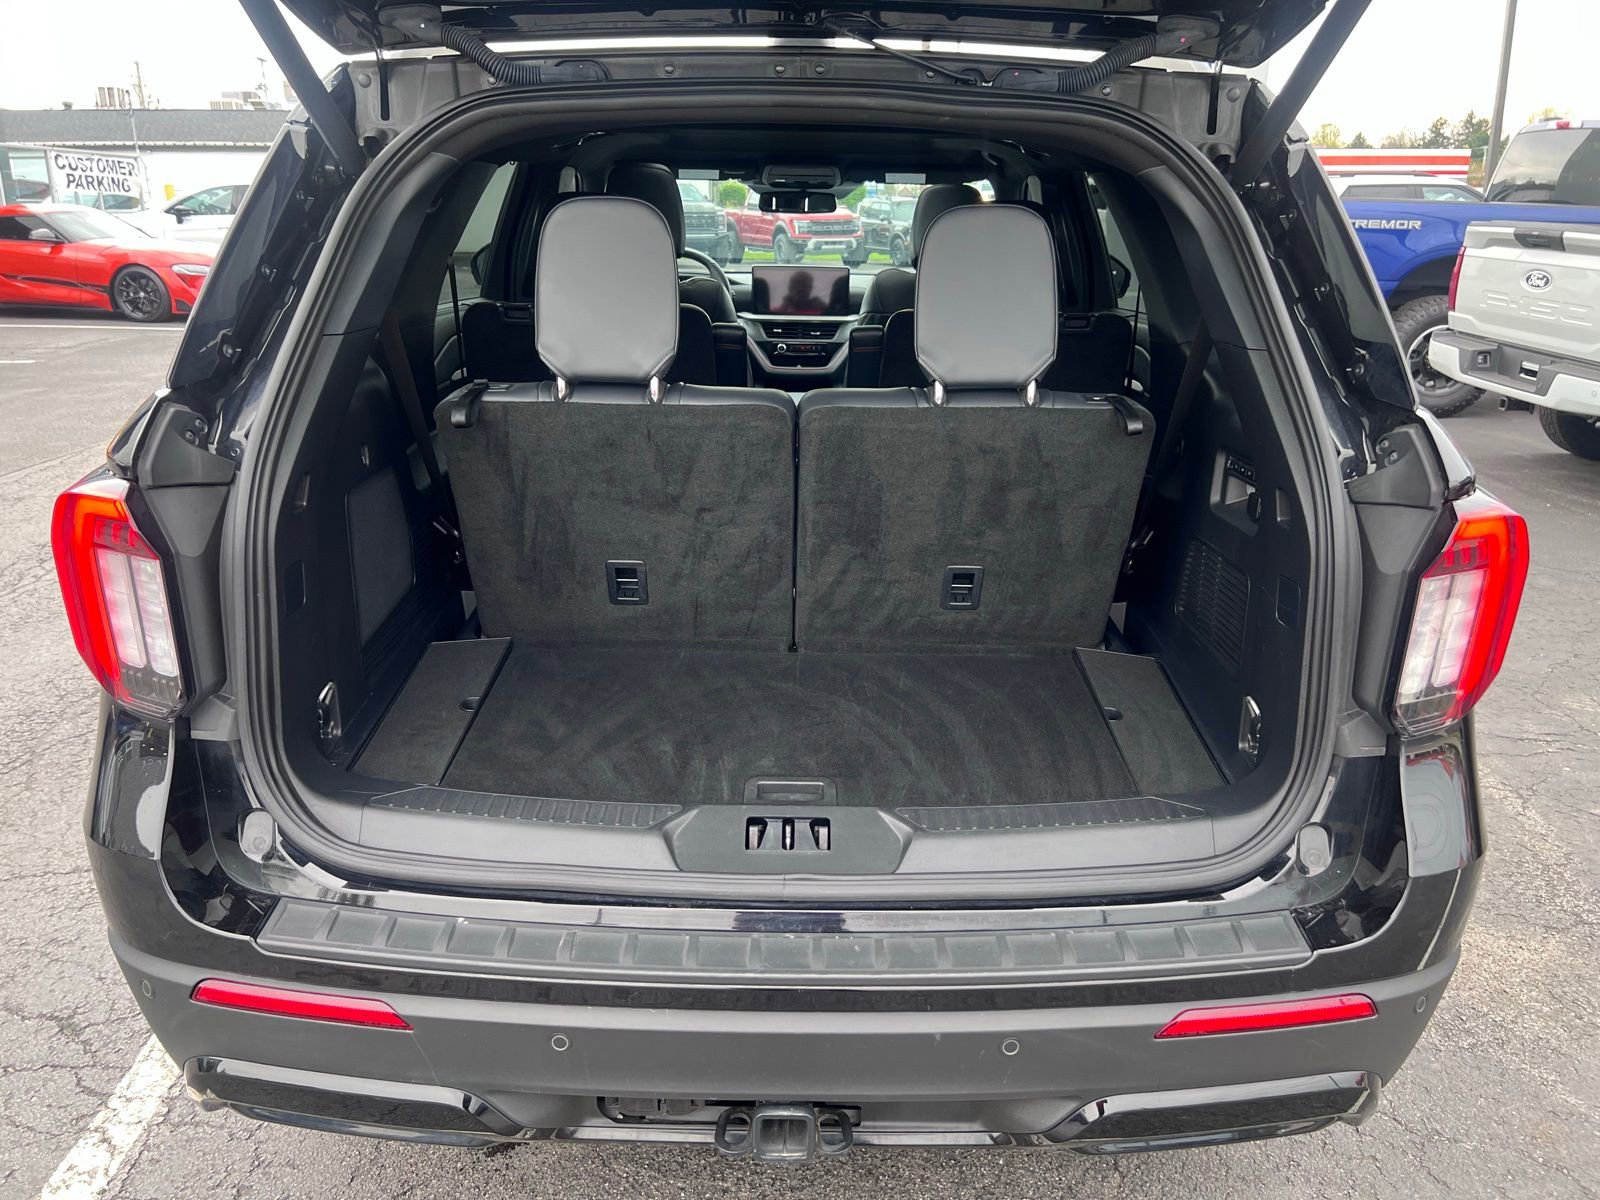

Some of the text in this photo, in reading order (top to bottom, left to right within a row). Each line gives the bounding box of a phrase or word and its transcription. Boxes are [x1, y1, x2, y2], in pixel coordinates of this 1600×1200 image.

[54, 153, 138, 176] CUSTOMER
[66, 173, 131, 193] PARKING
[1527, 272, 1548, 287] Ford
[1480, 289, 1594, 327] F-150
